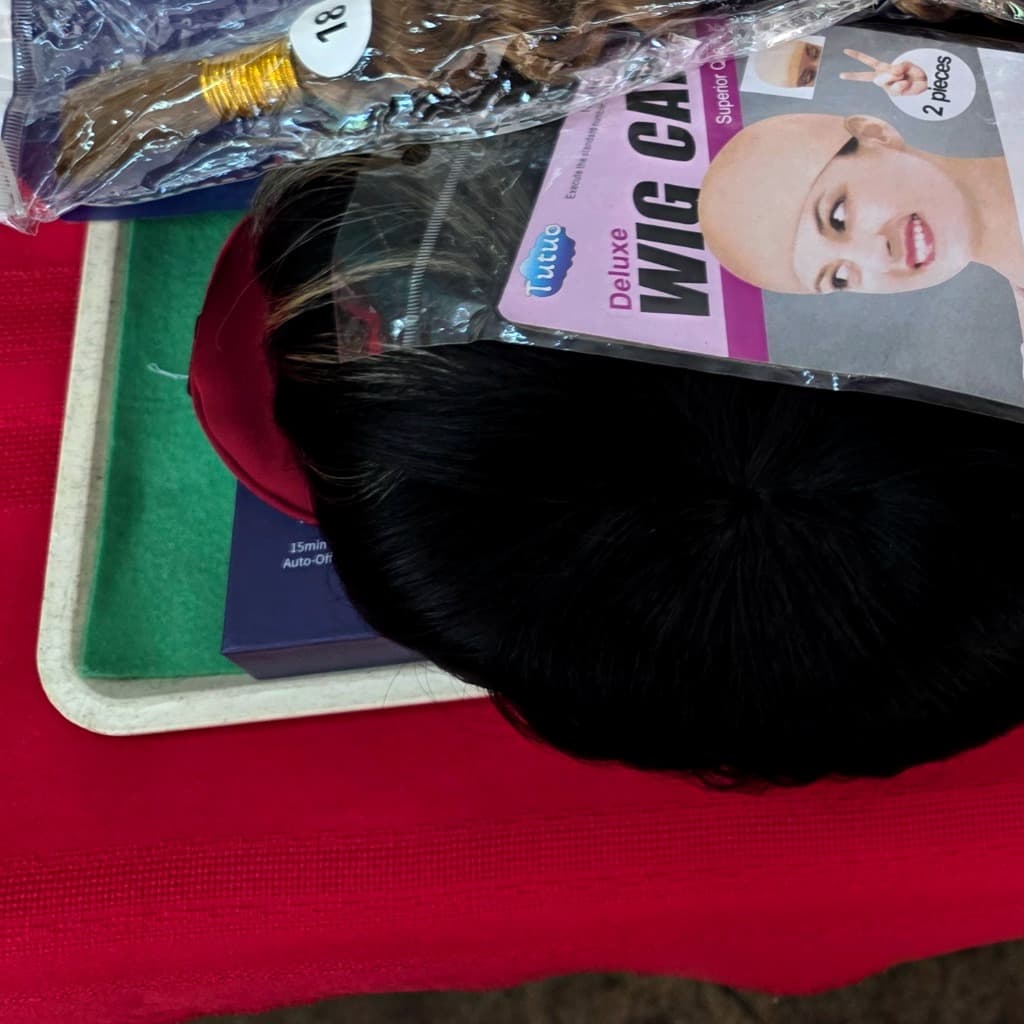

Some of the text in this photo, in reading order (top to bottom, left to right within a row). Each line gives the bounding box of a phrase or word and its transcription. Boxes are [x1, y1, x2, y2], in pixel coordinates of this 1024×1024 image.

[314, 4, 348, 43] 18
[714, 74, 734, 125] Superior
[922, 55, 952, 117] 2 pieces
[525, 224, 562, 297] Tutuo
[608, 227, 633, 311] Deluxe
[632, 180, 711, 317] WIG
[283, 552, 334, 569] Auto-Off
[290, 539, 327, 554] 15min
